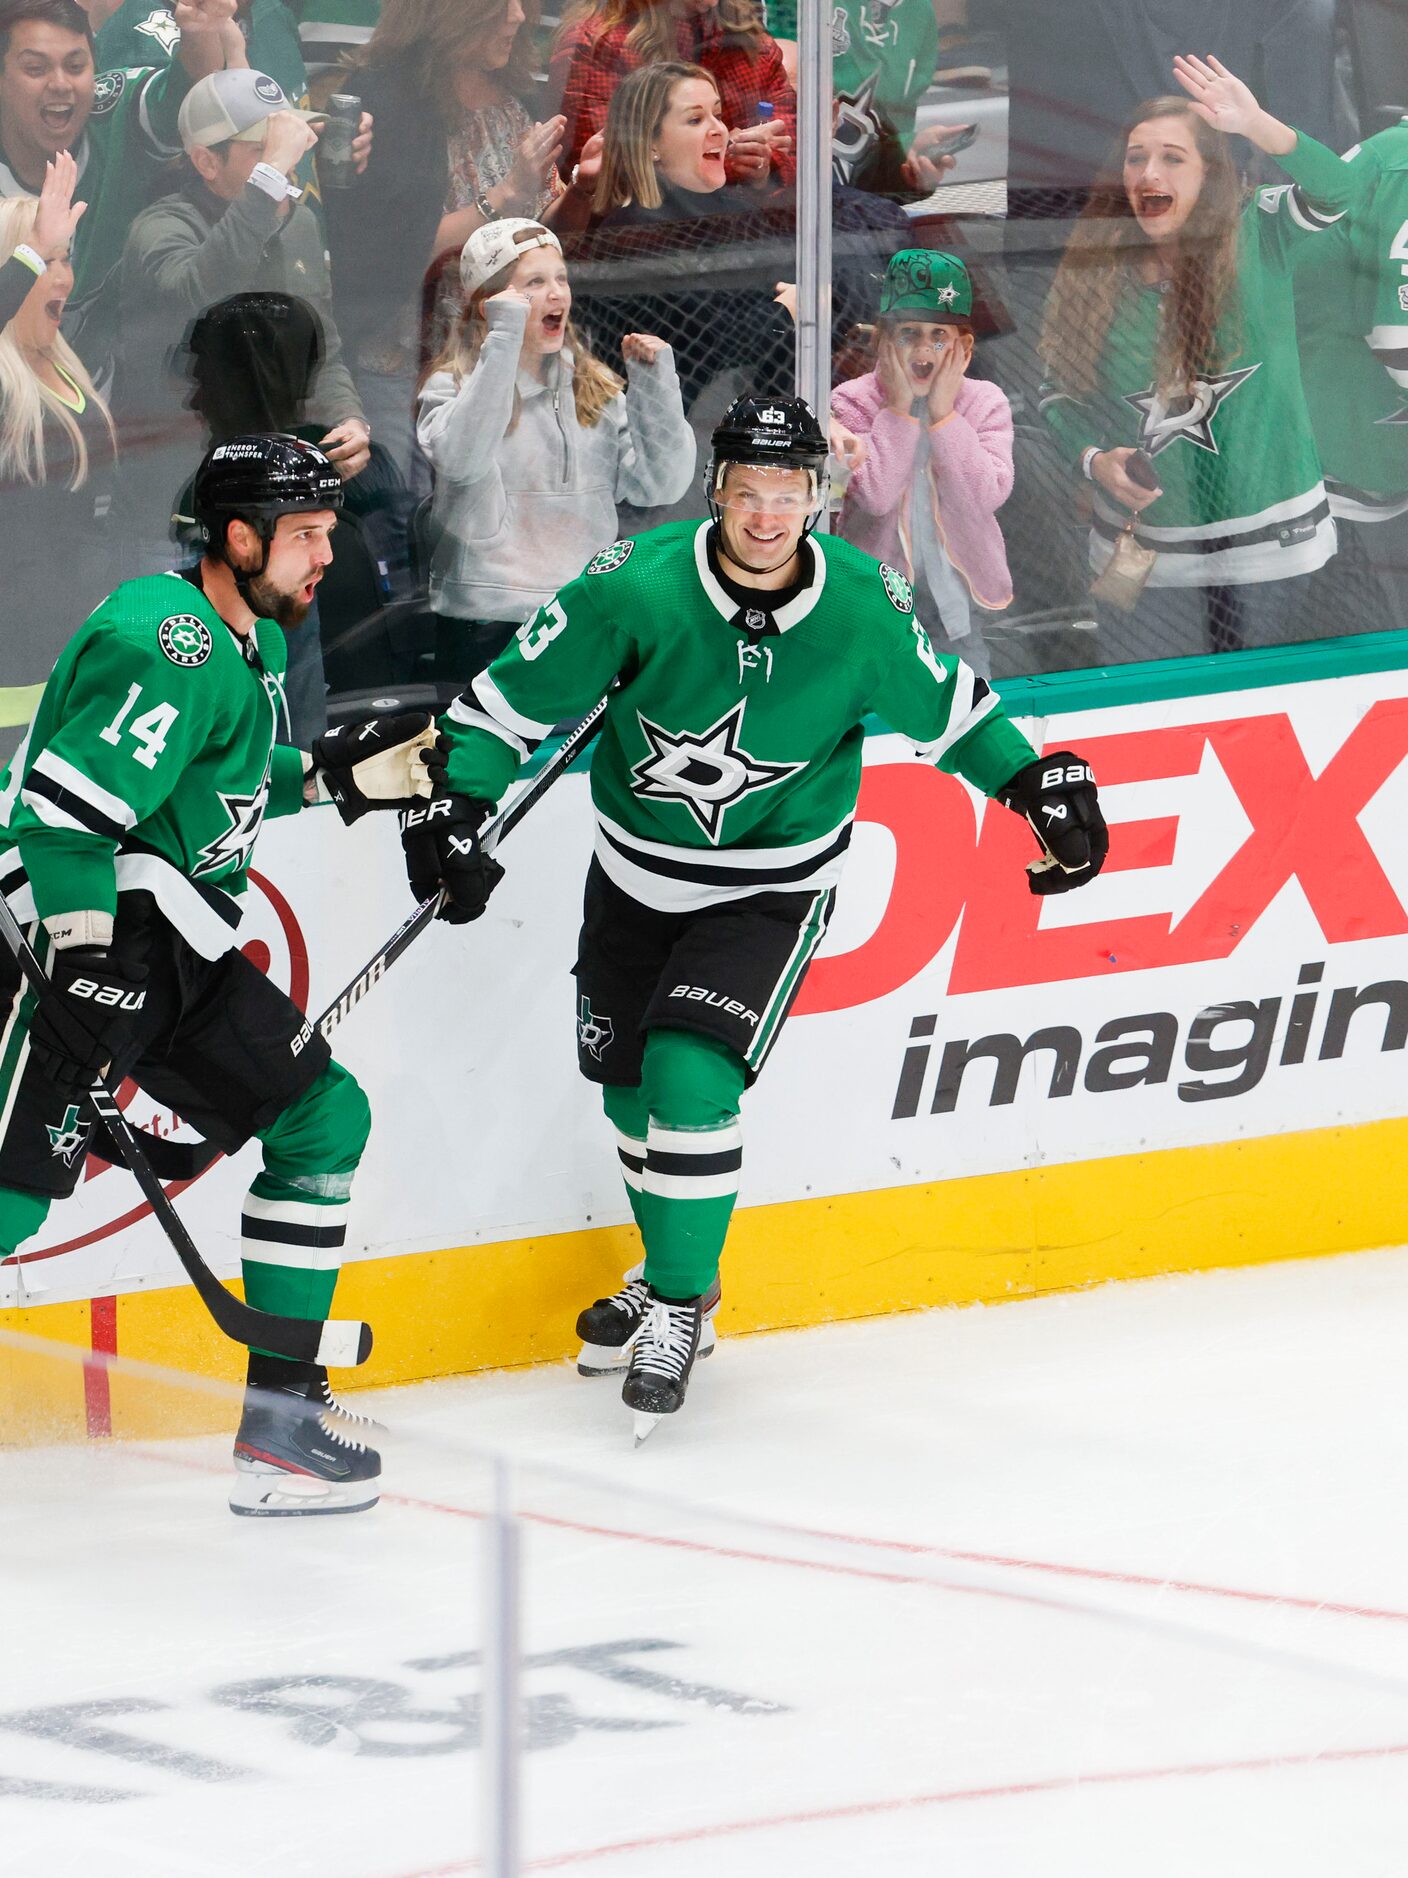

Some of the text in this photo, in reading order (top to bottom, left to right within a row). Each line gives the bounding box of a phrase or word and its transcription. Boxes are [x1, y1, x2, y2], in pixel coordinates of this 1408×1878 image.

[761, 409, 786, 425] 63
[226, 443, 259, 452] ENERGY
[751, 438, 792, 448] BAUER
[224, 450, 264, 461] TRANSFER
[319, 477, 341, 488] CCM
[168, 616, 209, 651] DALLAS
[161, 633, 199, 664] STARS
[99, 682, 180, 771] 14
[668, 984, 761, 1028] BAUER
